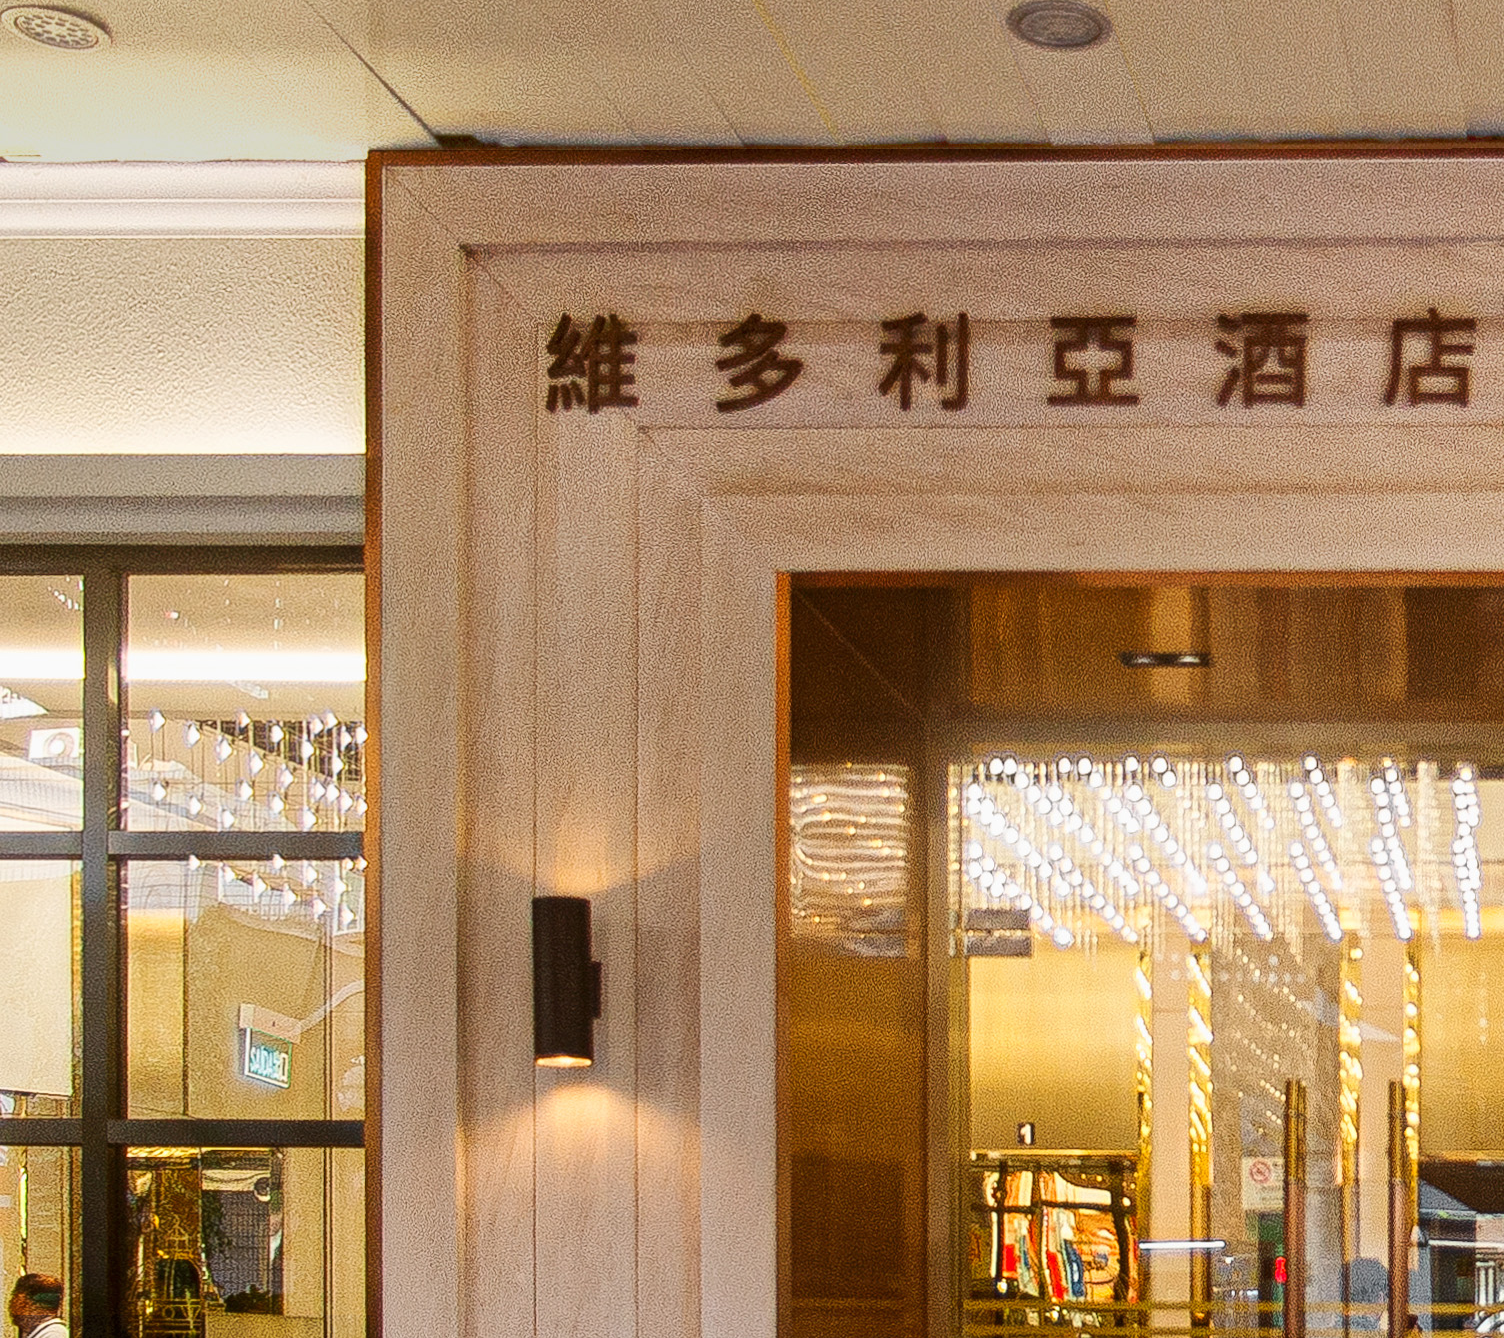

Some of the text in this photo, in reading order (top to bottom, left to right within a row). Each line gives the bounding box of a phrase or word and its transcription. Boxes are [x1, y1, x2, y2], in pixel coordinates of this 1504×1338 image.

[544, 308, 1477, 413] 維多利亞酒店
[1019, 1123, 1034, 1145] 1
